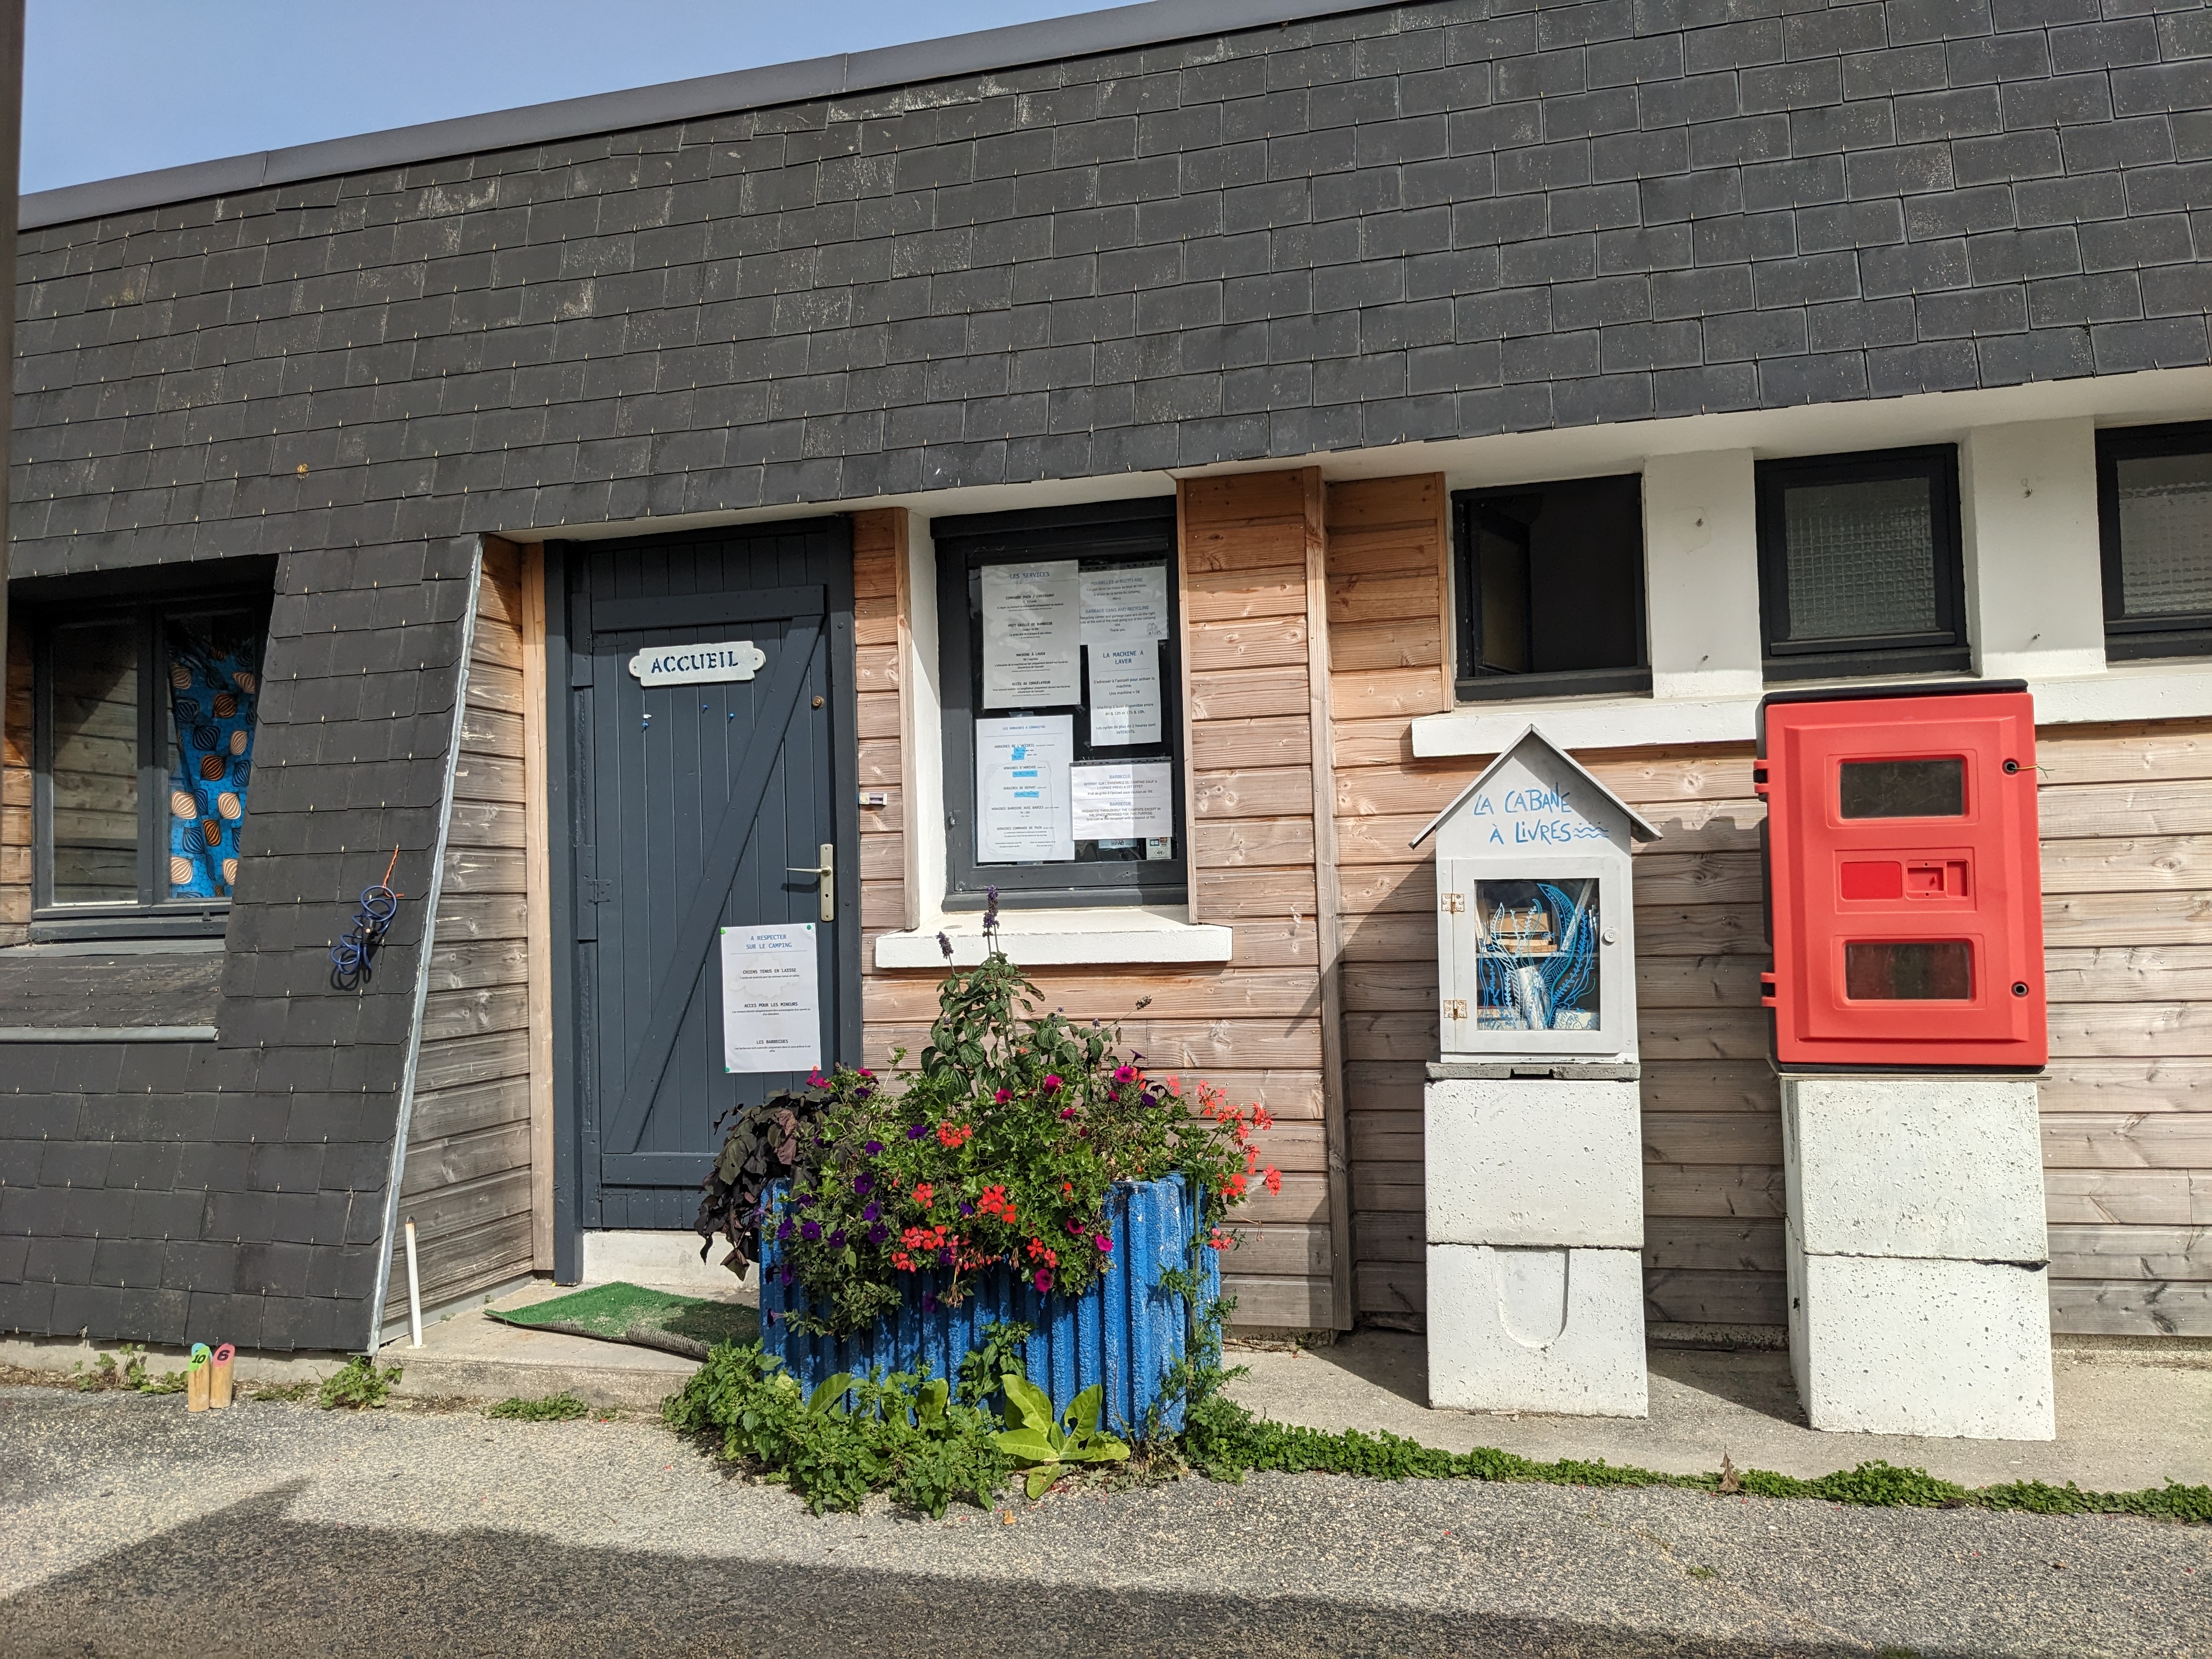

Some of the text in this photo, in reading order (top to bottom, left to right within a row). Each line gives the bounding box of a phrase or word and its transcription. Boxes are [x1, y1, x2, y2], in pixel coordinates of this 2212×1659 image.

[651, 651, 739, 674] ACCUEIL
[1474, 782, 1572, 815] LA CABANE
[1489, 823, 1504, 844] À
[191, 1355, 206, 1363] 10
[217, 1350, 230, 1361] 6
